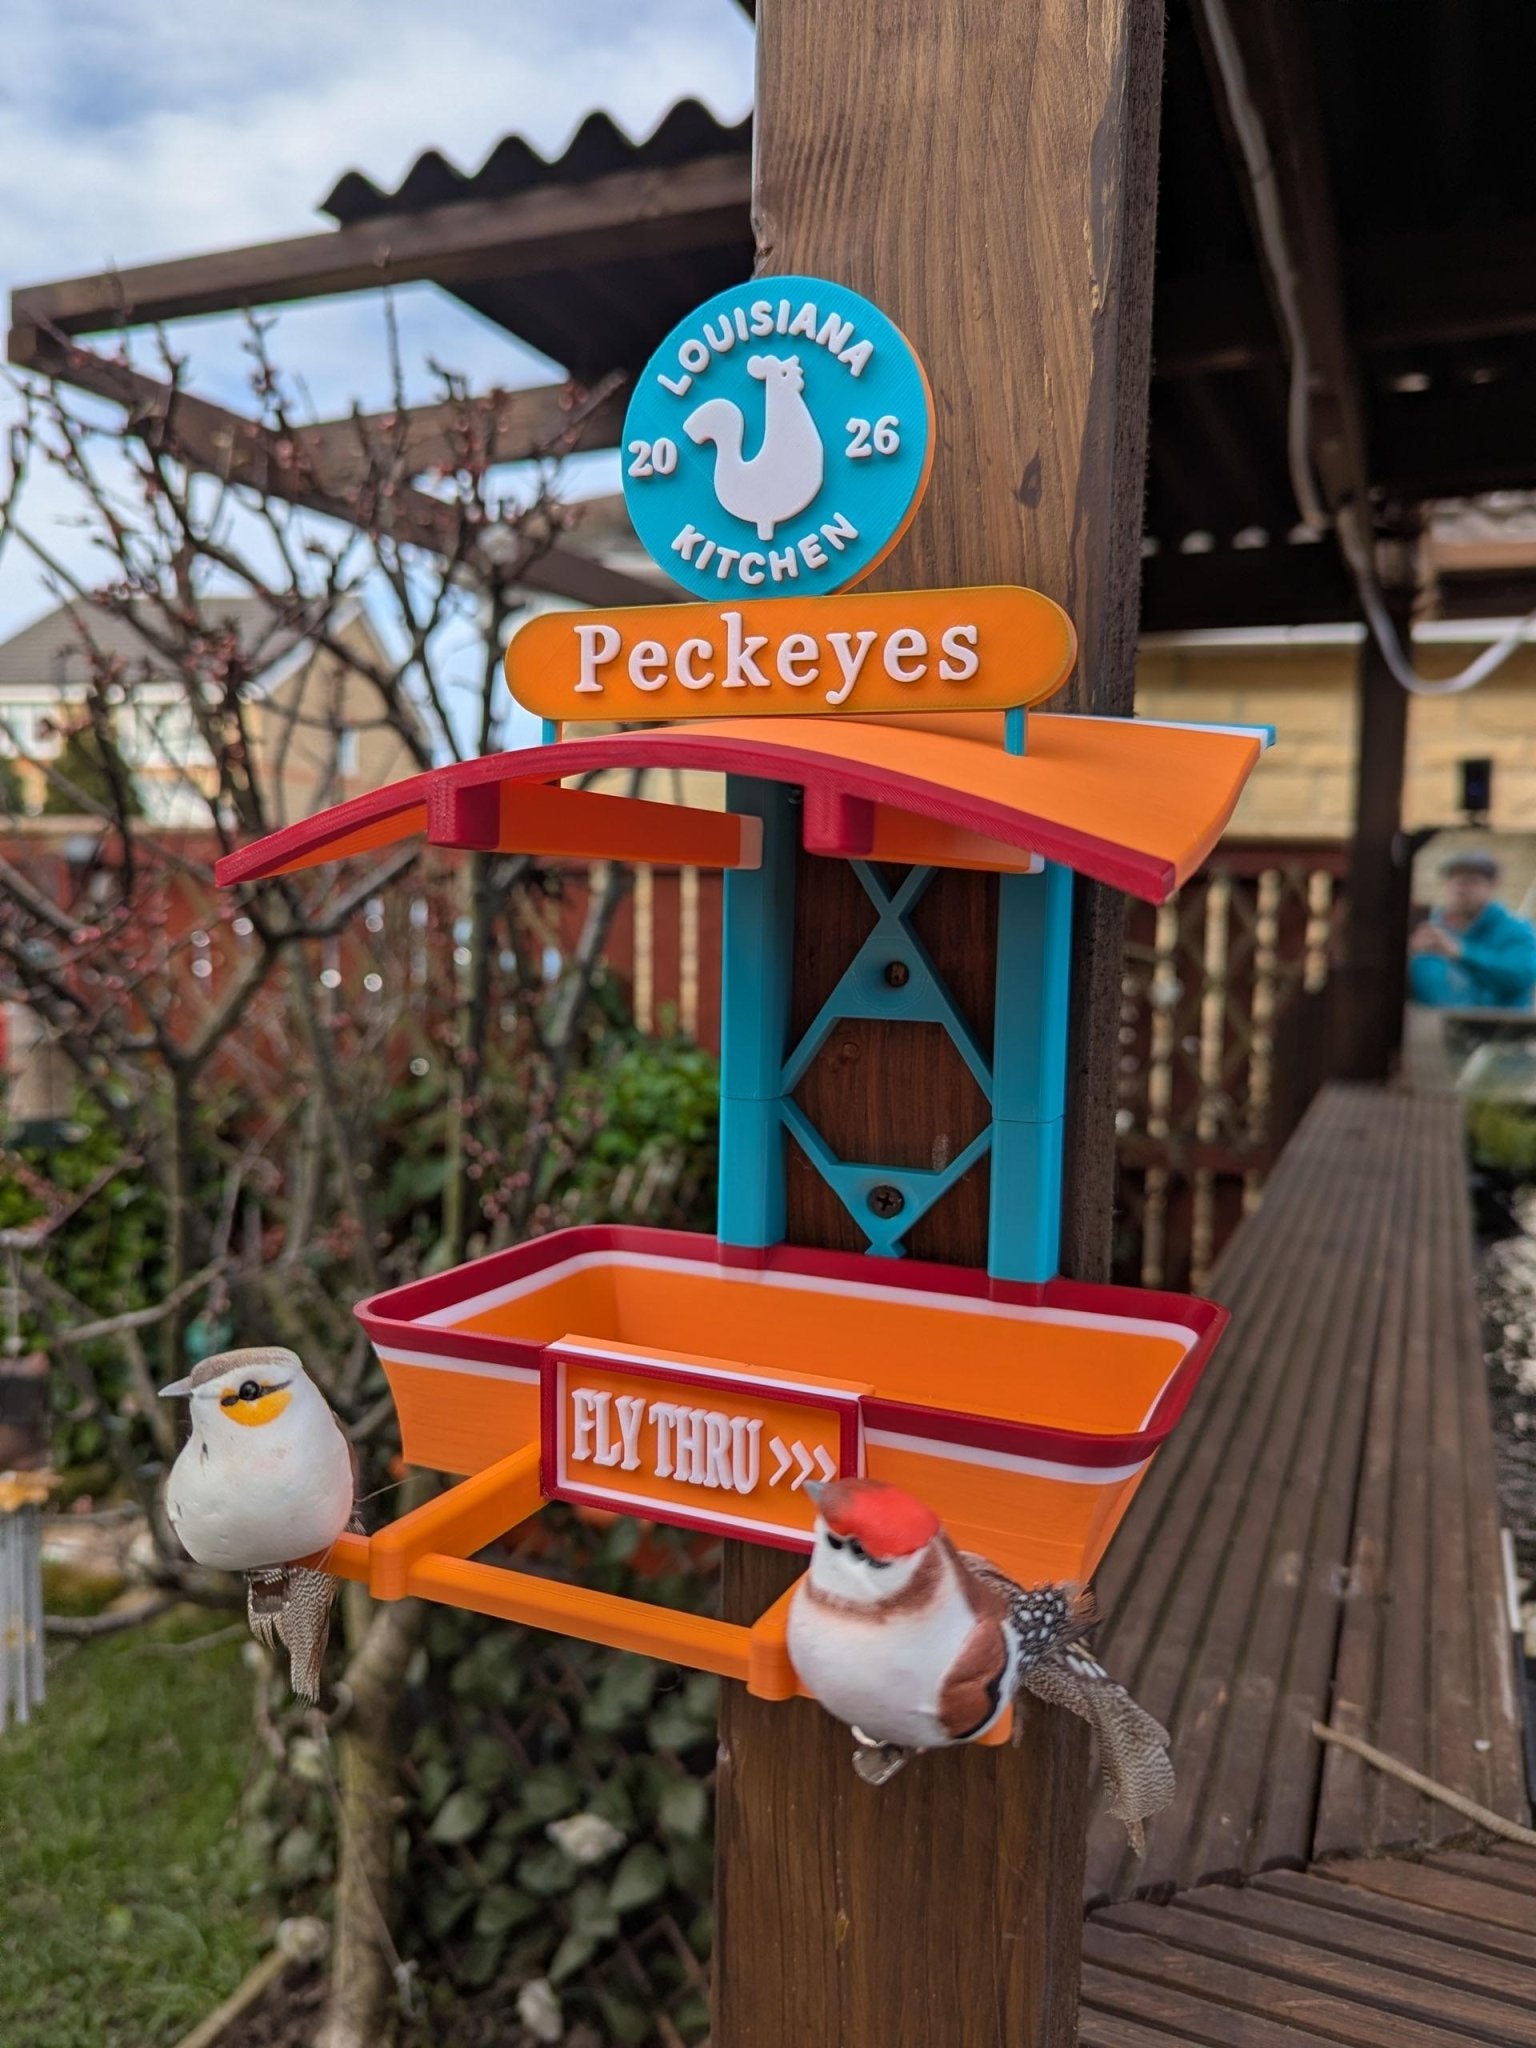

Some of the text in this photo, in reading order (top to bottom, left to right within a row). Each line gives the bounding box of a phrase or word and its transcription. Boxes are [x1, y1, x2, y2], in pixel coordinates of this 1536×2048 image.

[657, 299, 874, 397] LOUISIANA
[628, 415, 899, 477] 20 26
[671, 512, 858, 585] KITCHEN
[573, 611, 979, 705] Peckeyes
[571, 1387, 764, 1495] FLY THRU
